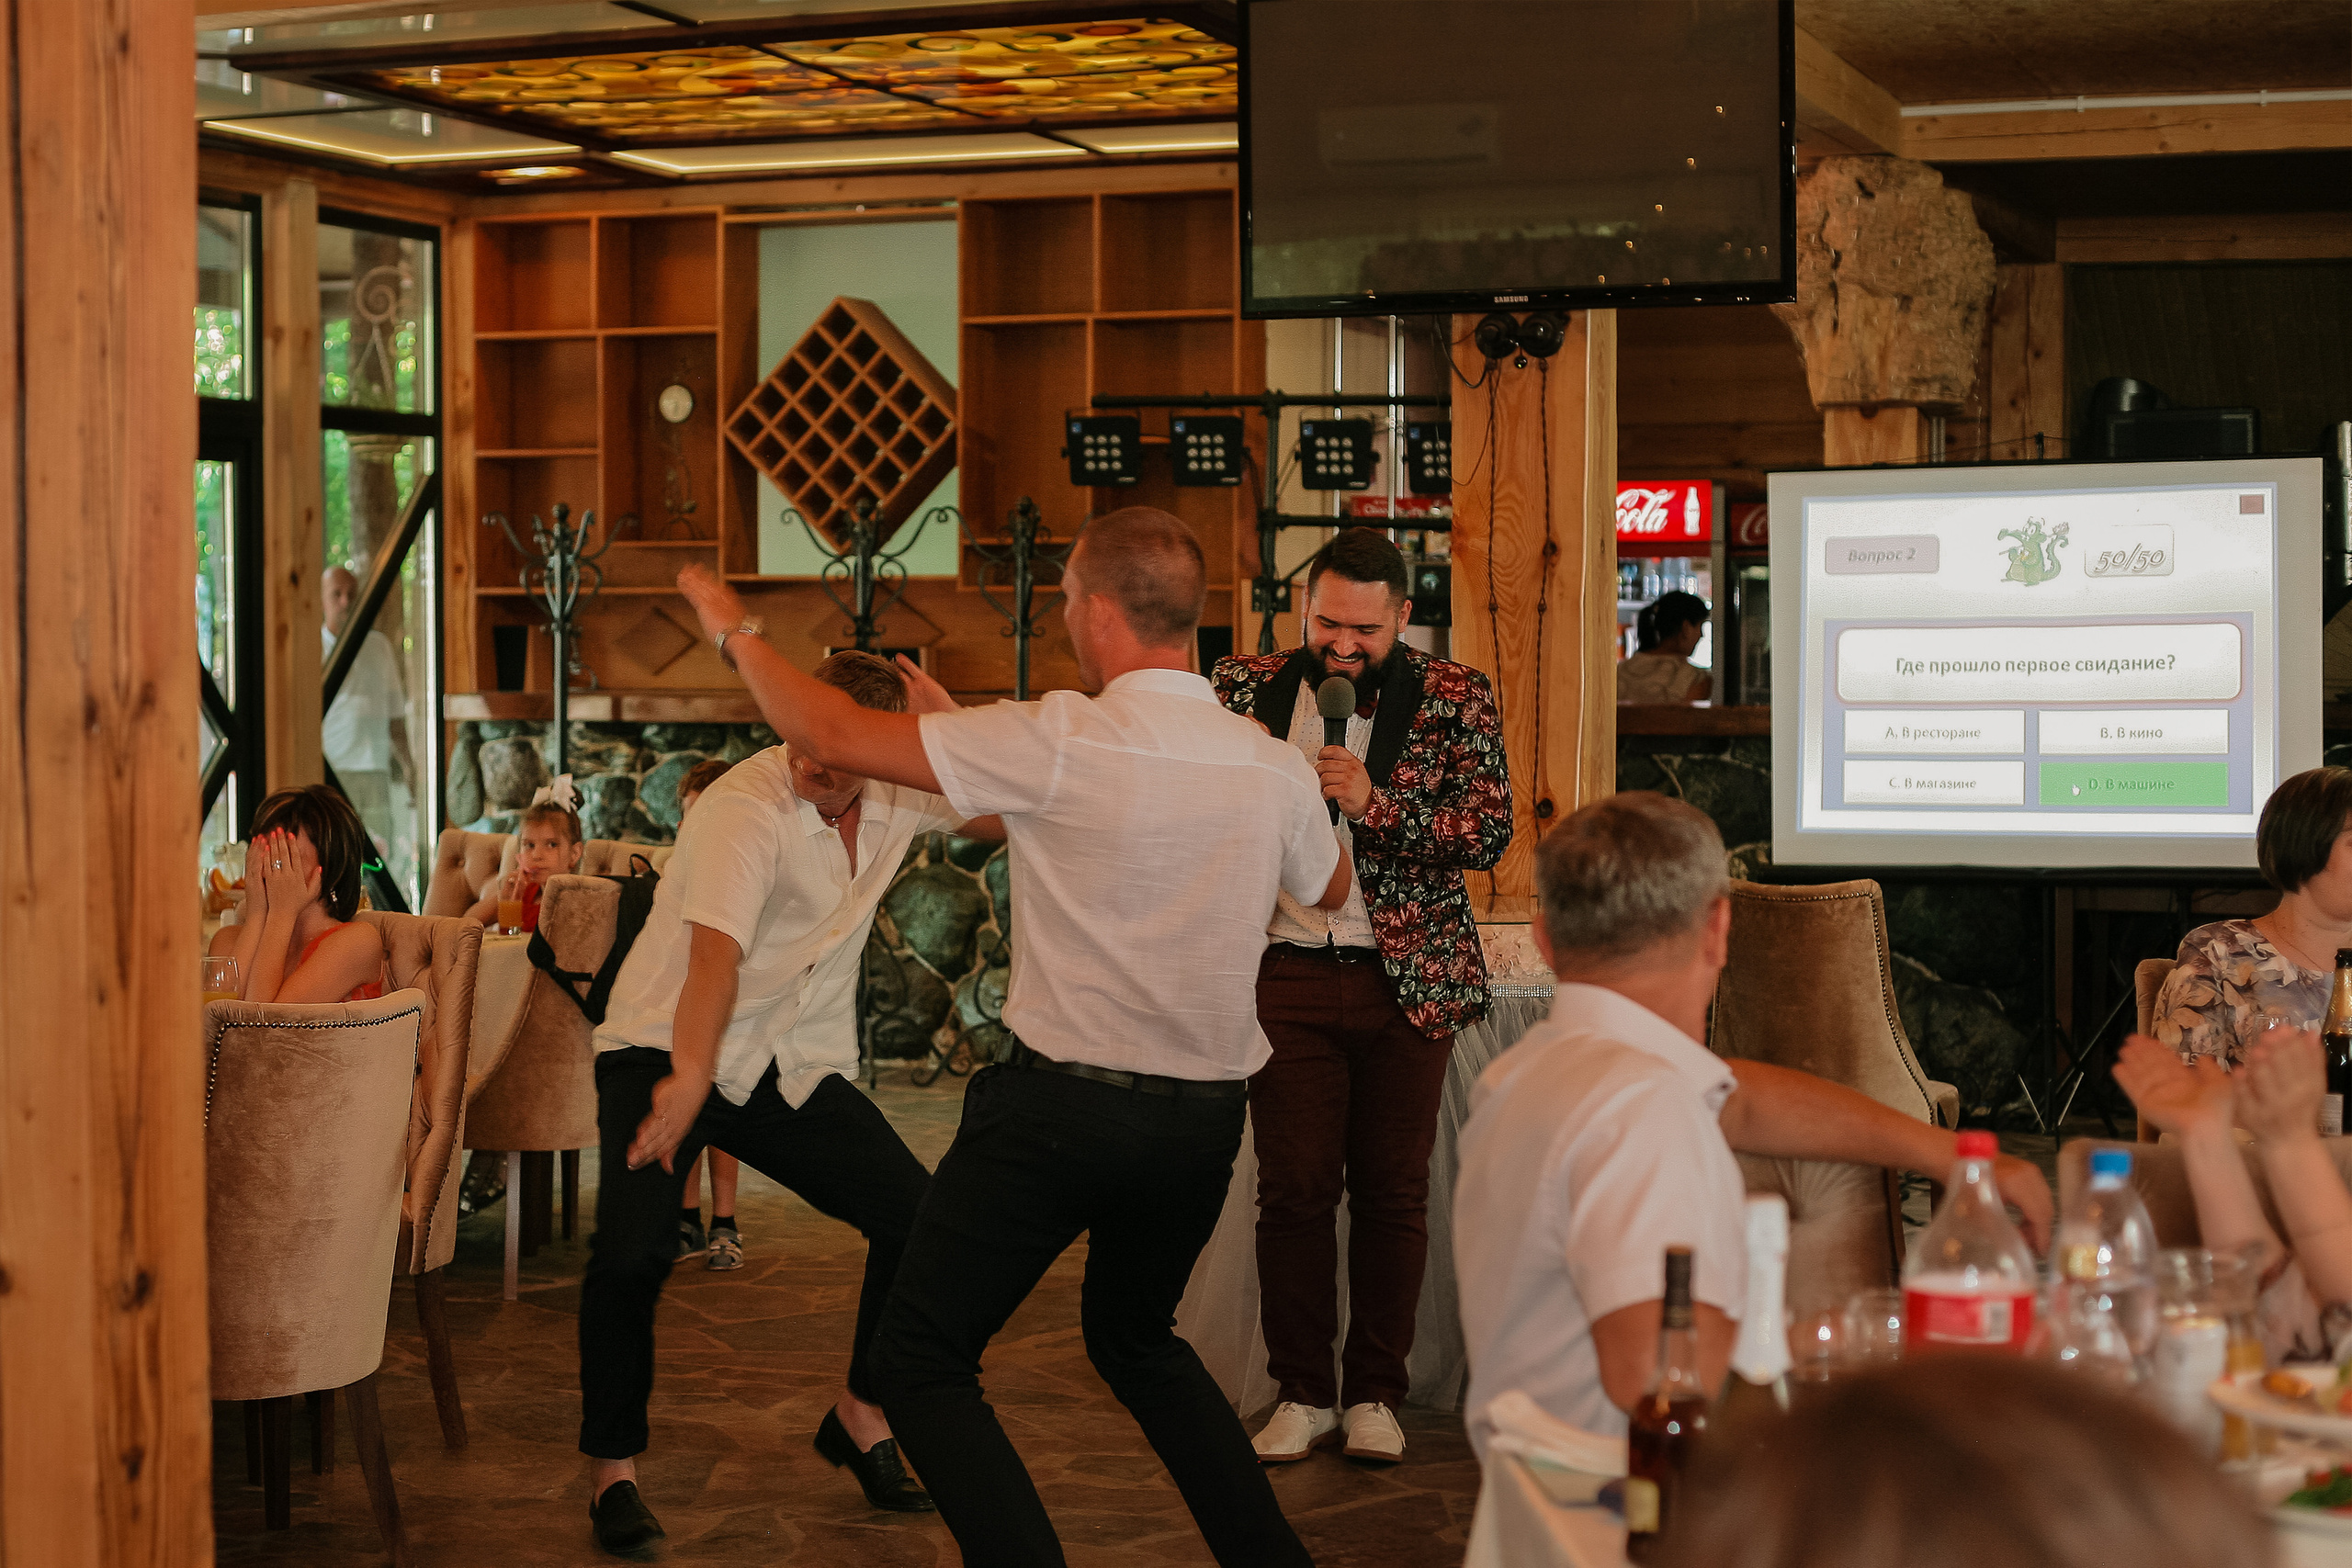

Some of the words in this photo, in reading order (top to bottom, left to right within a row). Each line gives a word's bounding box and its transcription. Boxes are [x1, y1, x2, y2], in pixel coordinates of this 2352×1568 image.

[1494, 295, 1529, 303] SAMSUNG
[1848, 548, 1905, 565] Вопрос
[1905, 547, 1917, 559] 2
[2093, 542, 2166, 573] 50/50
[1895, 657, 1925, 677] Где
[1928, 660, 2001, 677] прошло
[2005, 660, 2071, 677] первое
[2075, 653, 2177, 676] свидание?
[1913, 728, 1982, 741] ресторане
[2129, 728, 2164, 739] кино
[1916, 780, 1977, 789] магазине
[2118, 780, 2176, 790] машине
